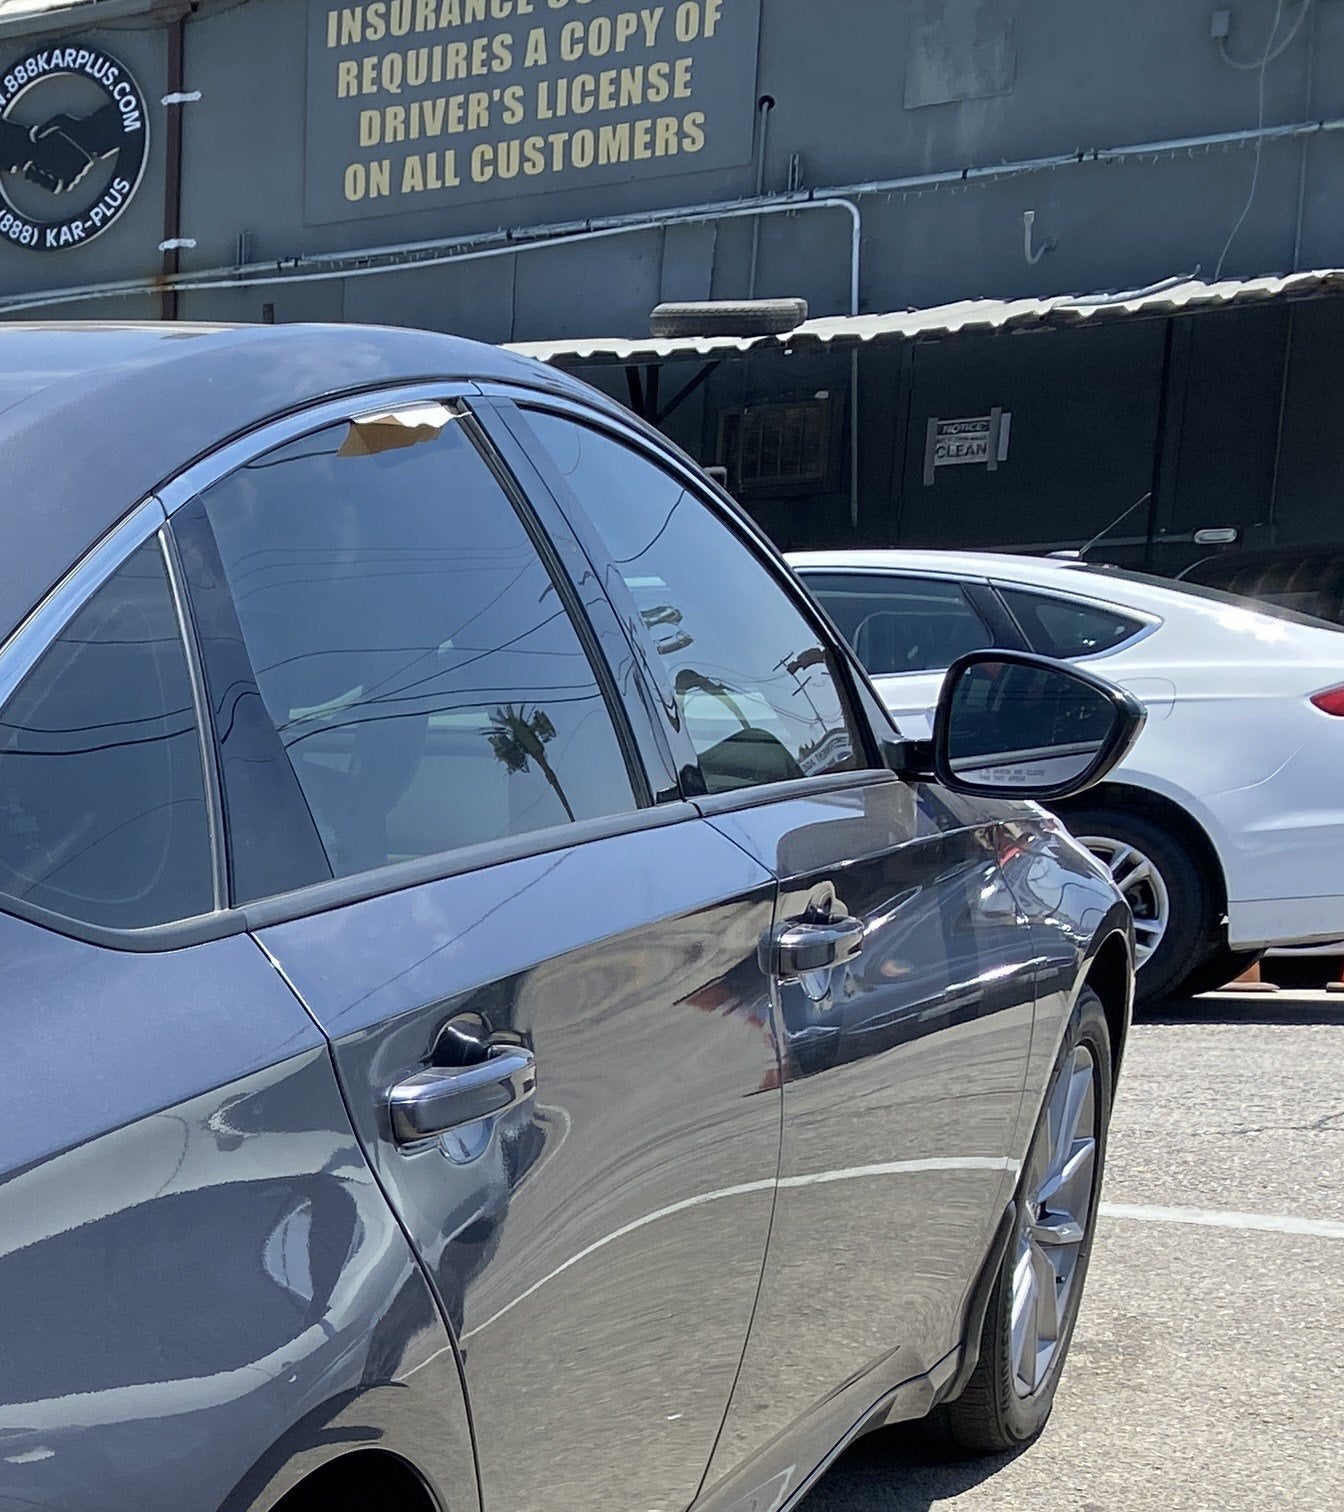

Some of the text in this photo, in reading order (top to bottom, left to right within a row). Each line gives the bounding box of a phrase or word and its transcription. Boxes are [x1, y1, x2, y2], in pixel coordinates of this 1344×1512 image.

[336, 0, 722, 98] REQUIRES A COPY OF
[359, 57, 693, 147] DRIVER'S LICENSE
[344, 111, 706, 202] ON ALL CUSTOMERS
[45, 177, 130, 248] KAR-PLUS
